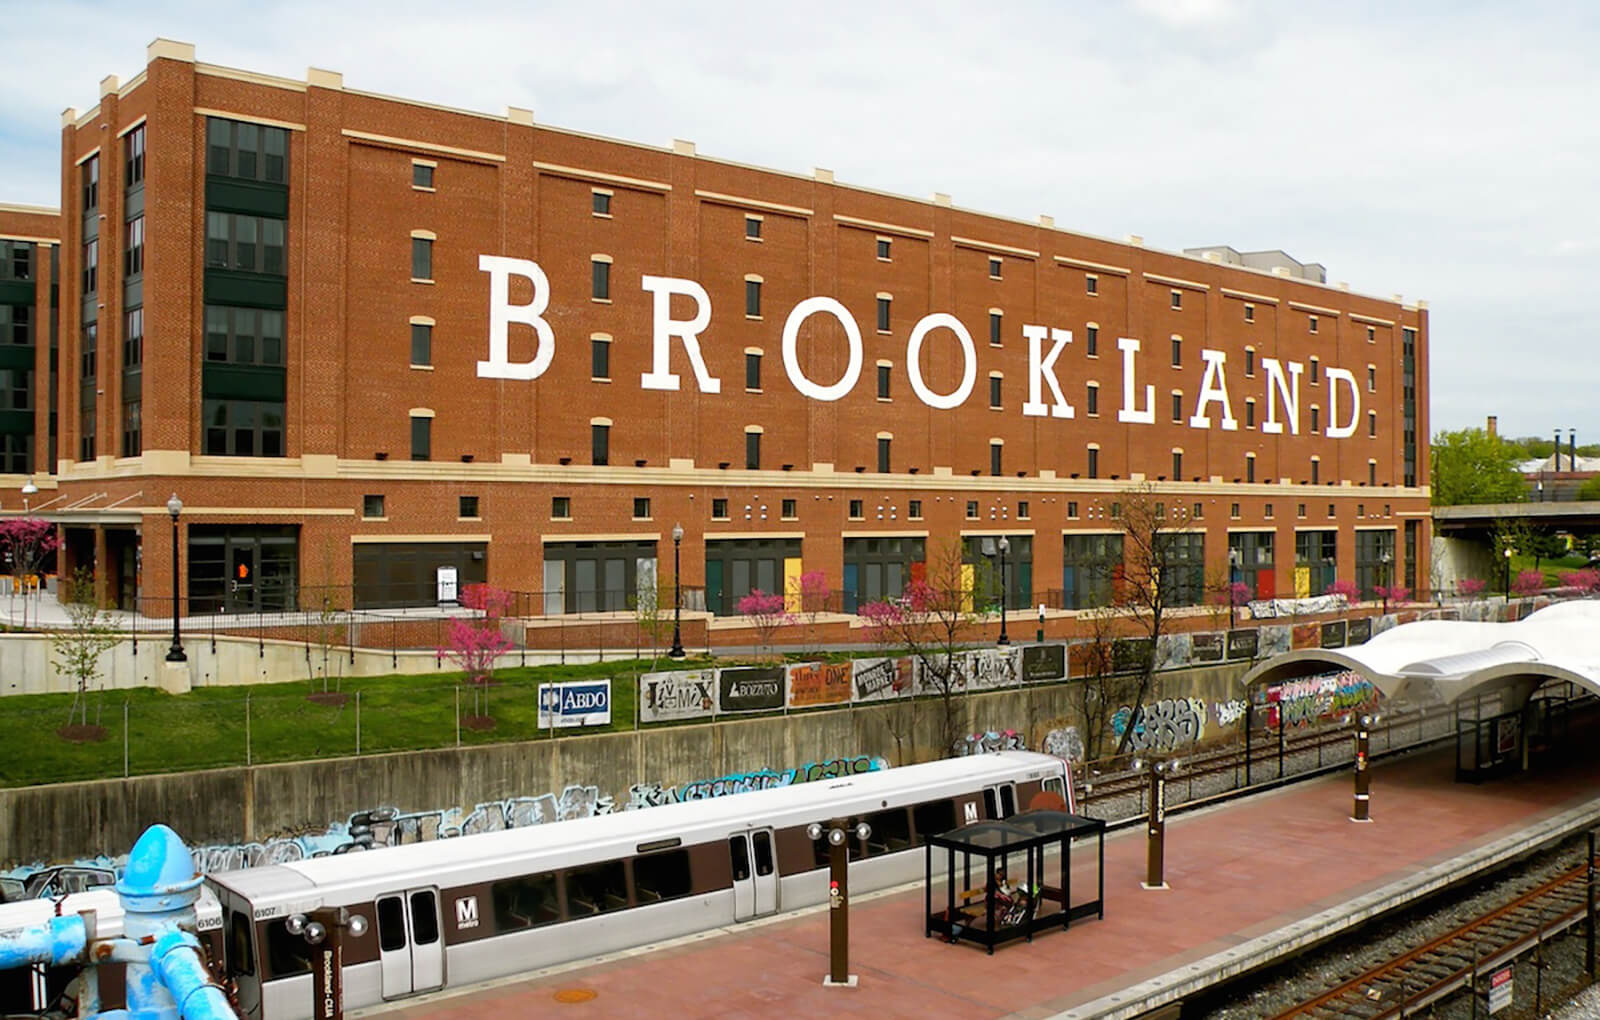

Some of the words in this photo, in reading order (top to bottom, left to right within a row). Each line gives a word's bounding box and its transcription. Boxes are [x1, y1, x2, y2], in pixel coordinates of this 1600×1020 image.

[476, 254, 1361, 438] BROOKLAND
[825, 667, 849, 686] ONE
[739, 682, 778, 697] BOZZUTO
[563, 690, 606, 709] ABDO
[255, 907, 276, 918] 6107
[457, 897, 478, 921] M
